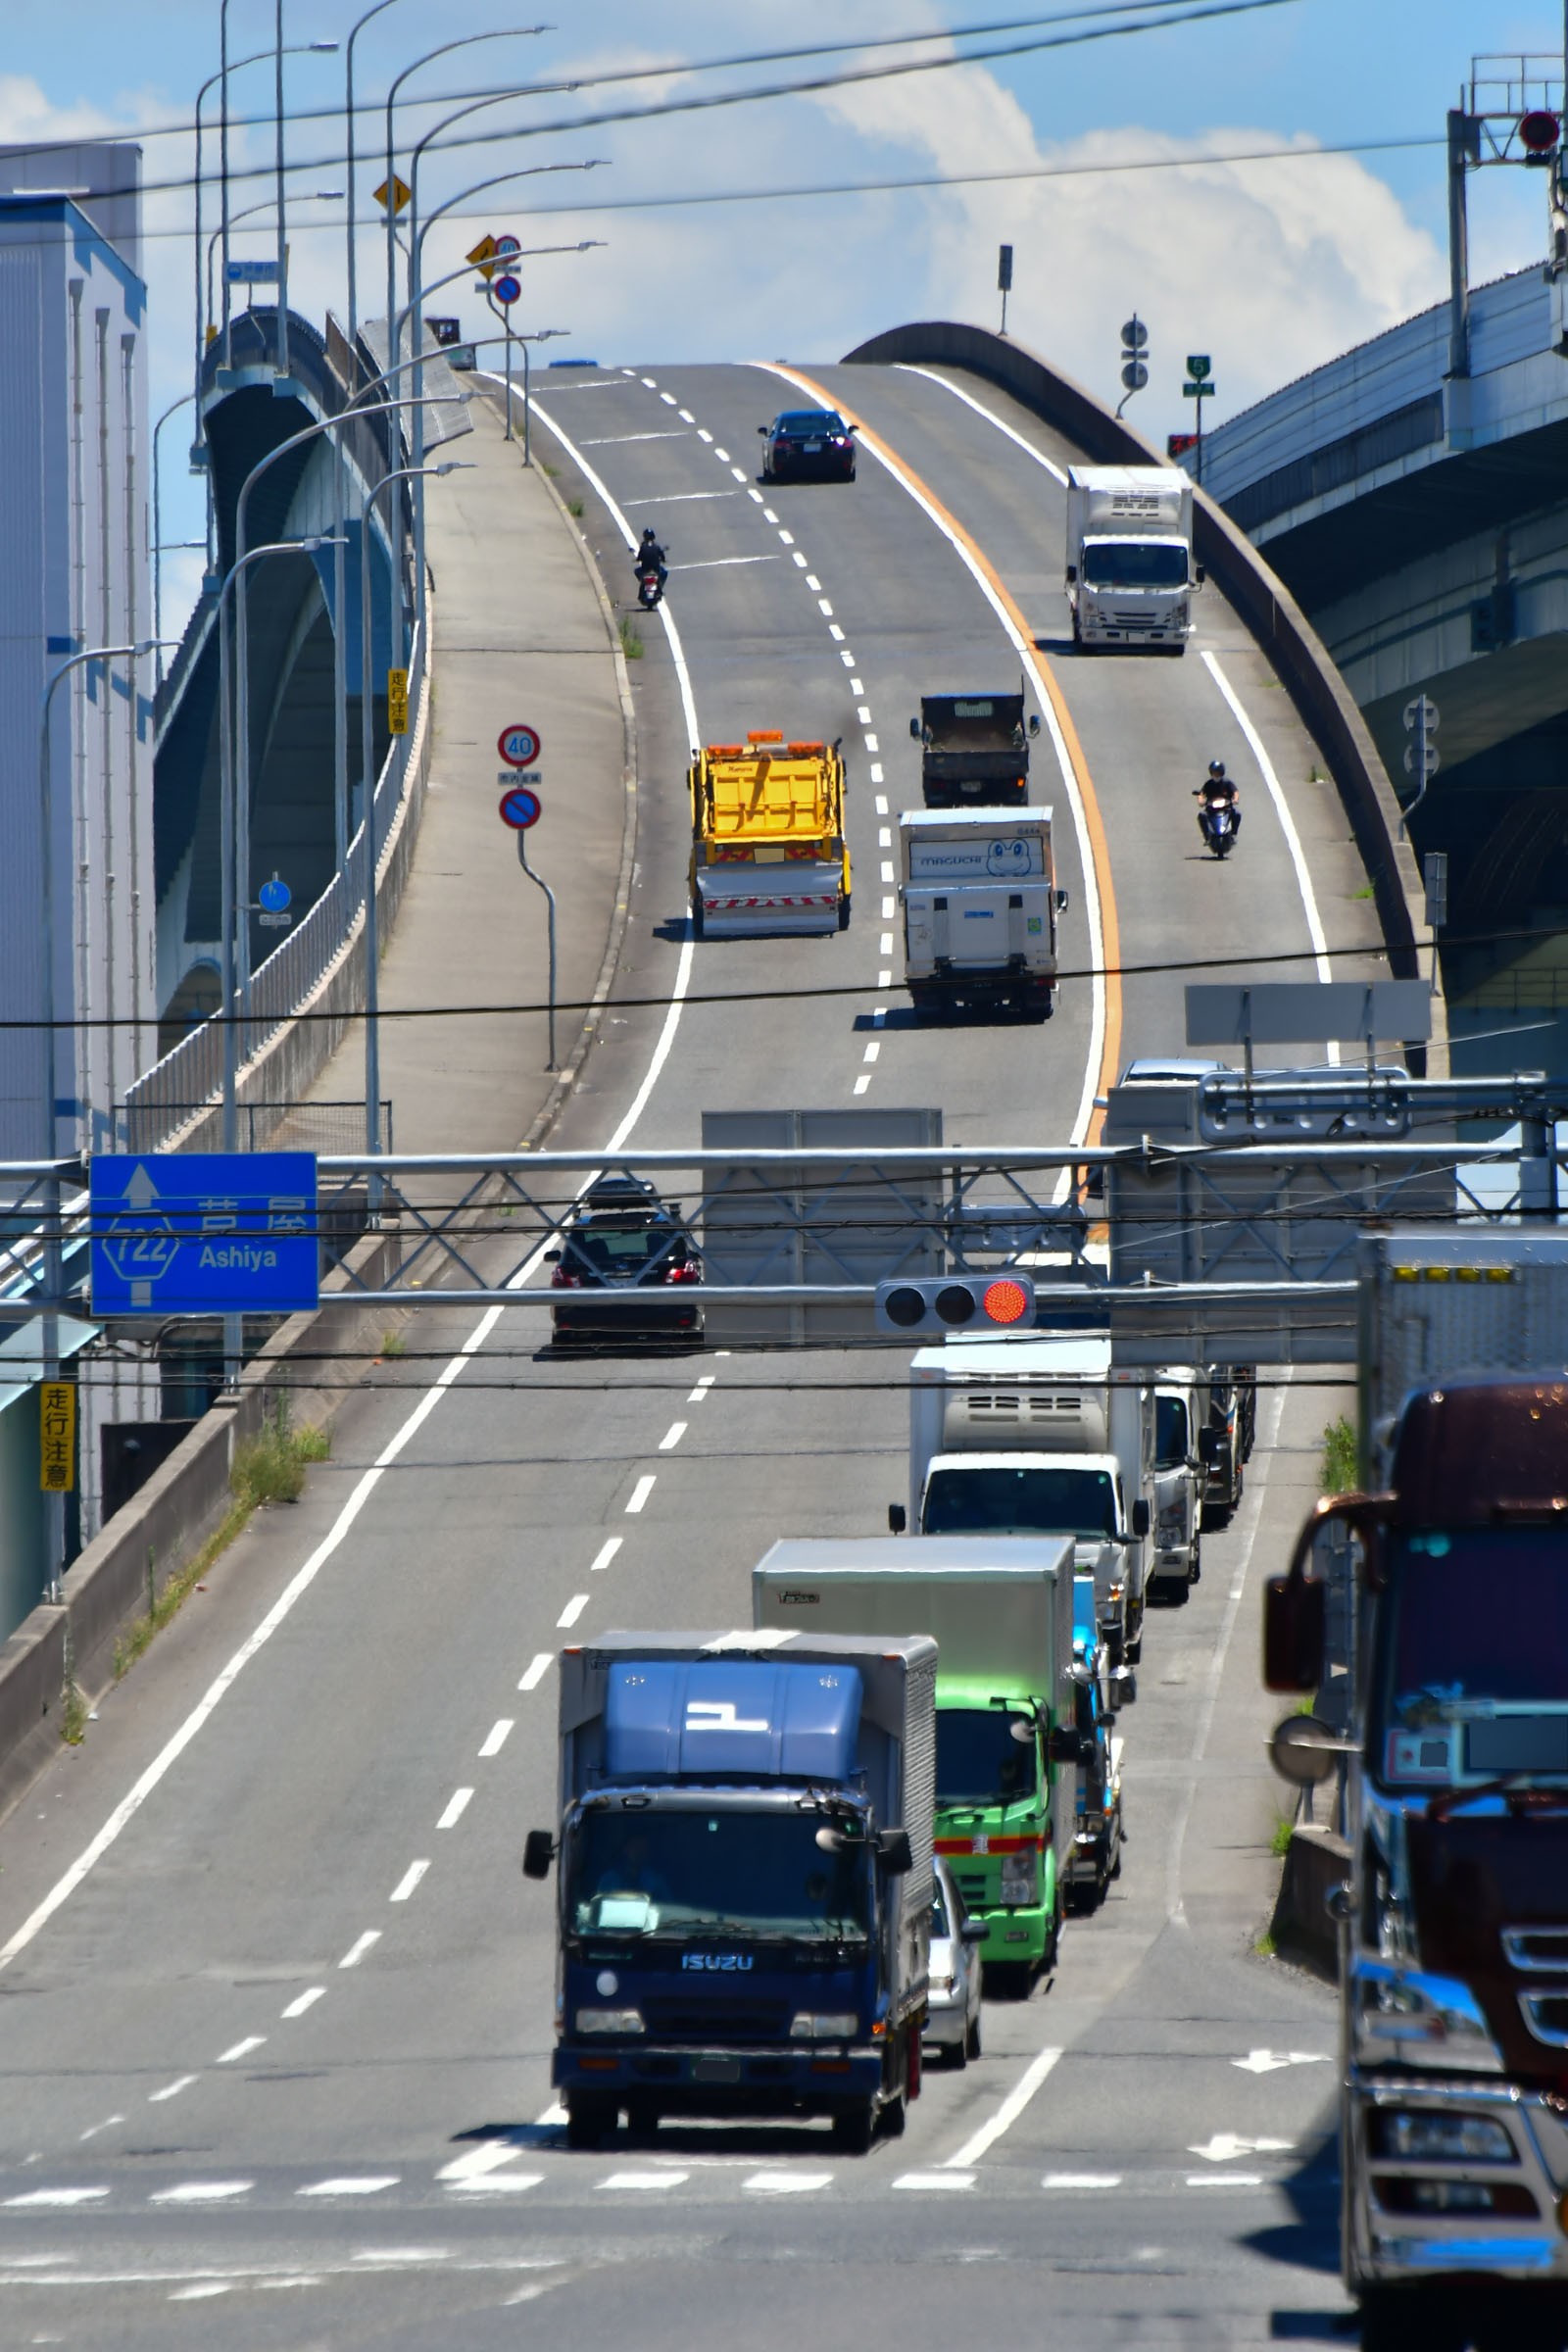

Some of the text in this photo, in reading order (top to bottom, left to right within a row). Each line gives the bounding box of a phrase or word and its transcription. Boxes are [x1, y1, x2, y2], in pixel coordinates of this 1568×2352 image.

[1193, 359, 1204, 374] 5
[508, 736, 531, 755] 40
[109, 1227, 168, 1262] 722
[199, 1245, 277, 1273] Ashiya
[45, 1388, 70, 1489] 走行注意
[681, 1954, 753, 1971] ISUZU
